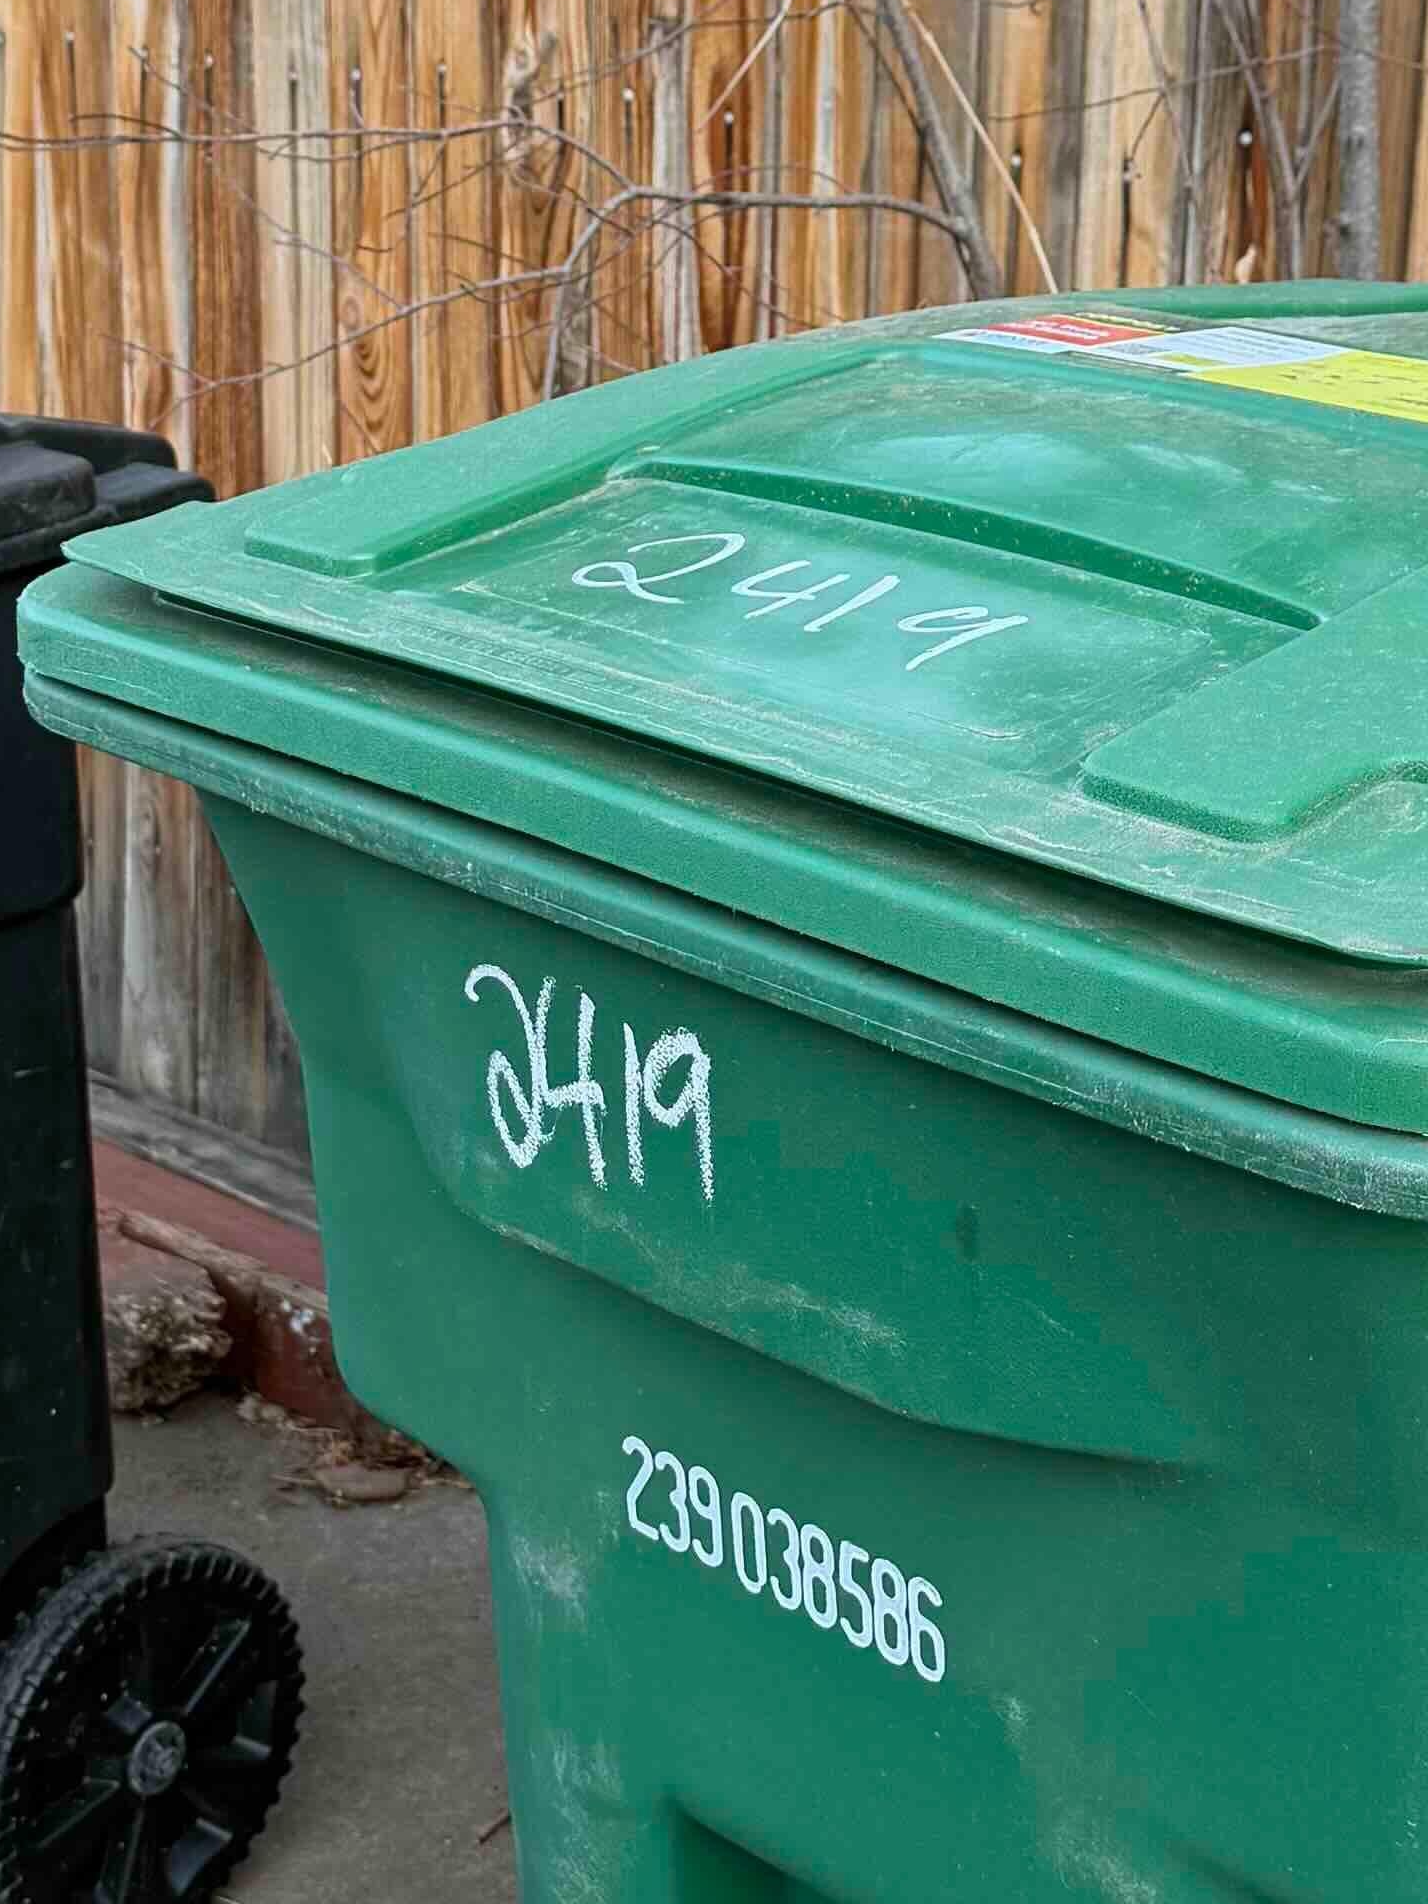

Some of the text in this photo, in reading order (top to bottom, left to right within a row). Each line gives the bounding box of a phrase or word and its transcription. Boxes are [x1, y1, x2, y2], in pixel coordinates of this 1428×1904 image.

[571, 531, 1031, 671] 2419
[464, 963, 714, 1208] 2419
[622, 1435, 945, 1683] 239038586
